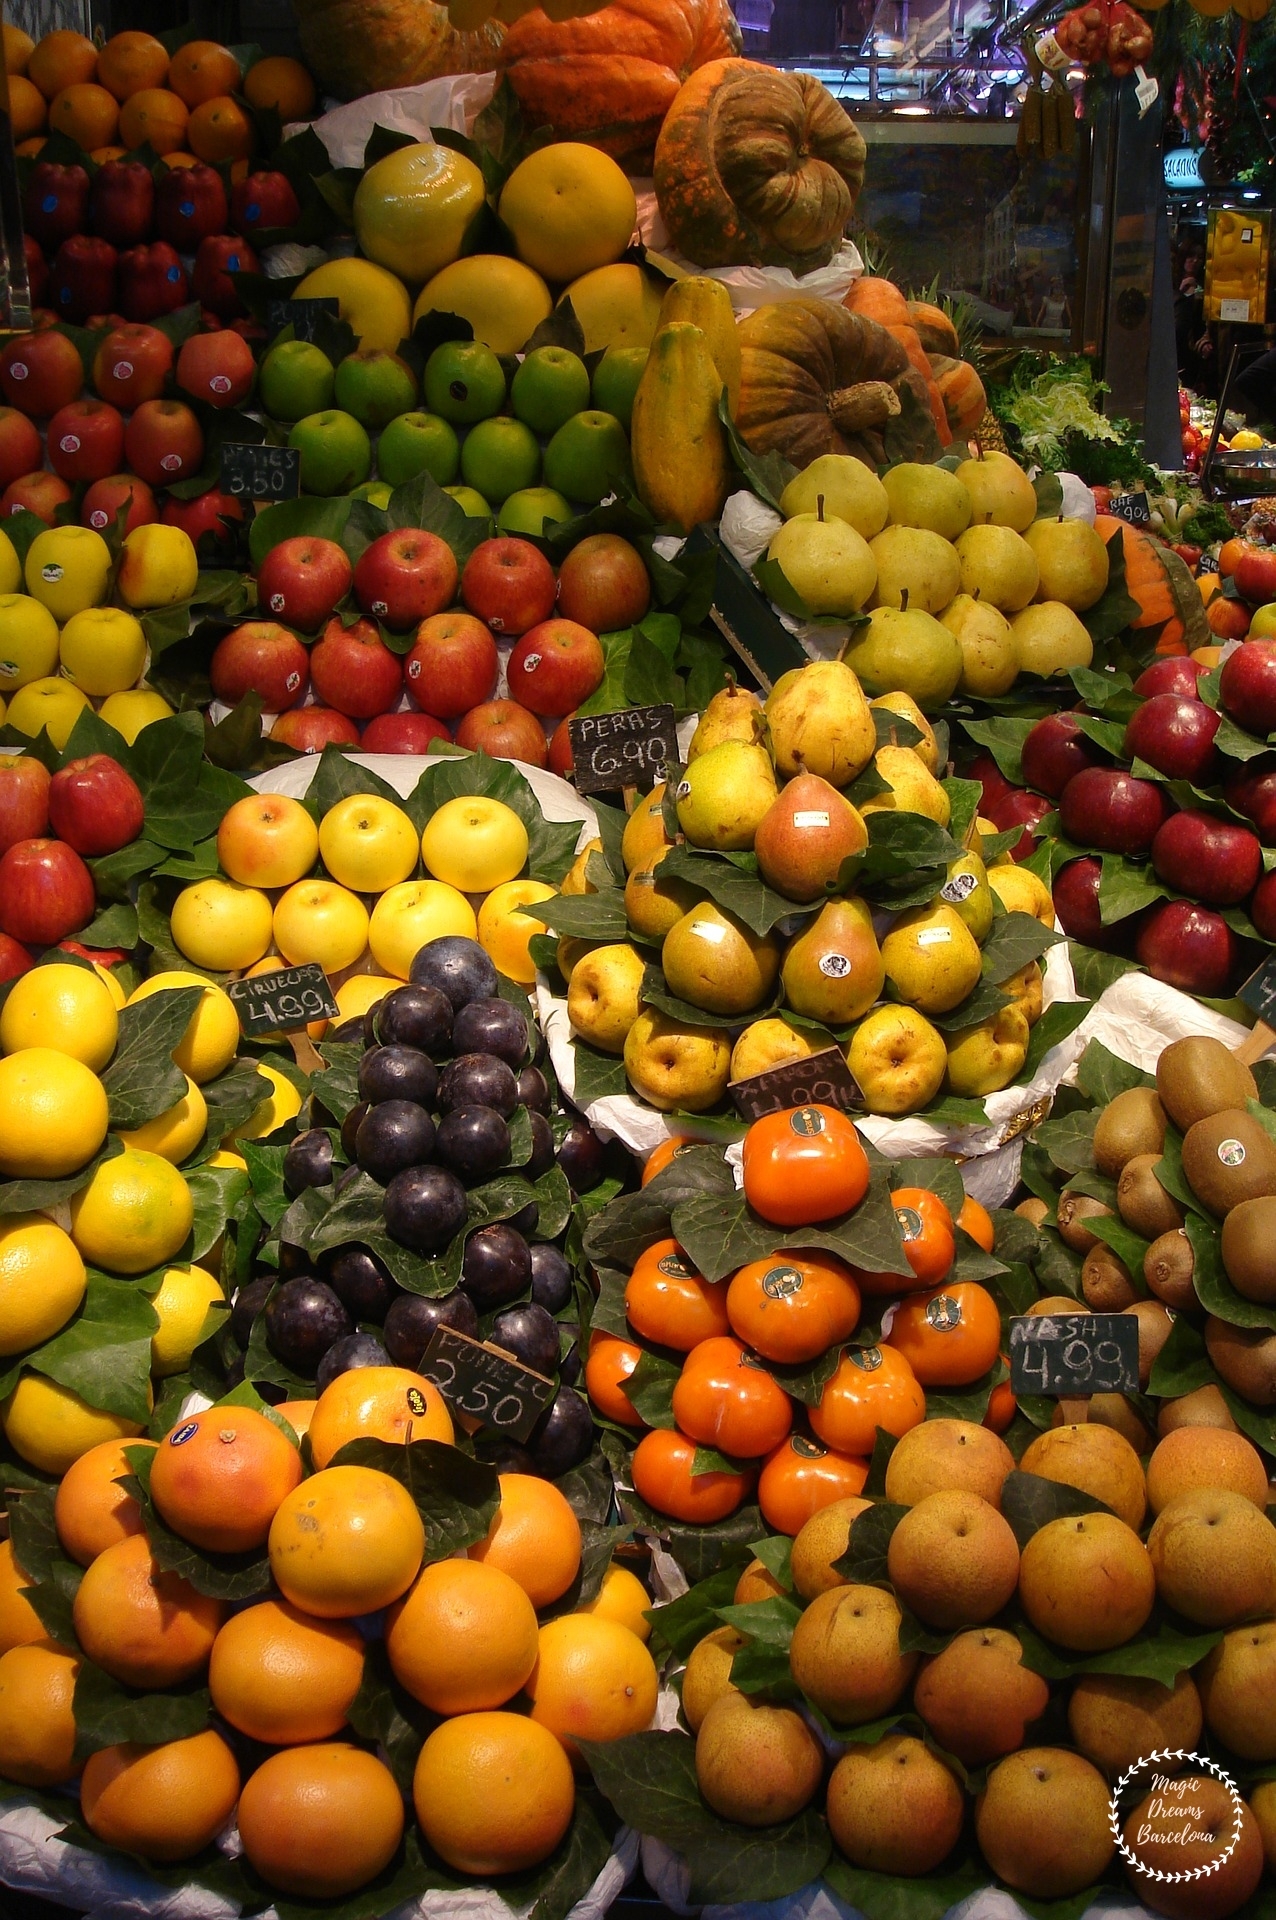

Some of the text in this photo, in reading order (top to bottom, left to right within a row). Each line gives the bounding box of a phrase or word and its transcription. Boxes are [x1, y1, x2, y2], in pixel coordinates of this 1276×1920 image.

[1110, 496, 1134, 510] RAF
[581, 709, 662, 741] PERAS
[1011, 1317, 1114, 1347] NASHI
